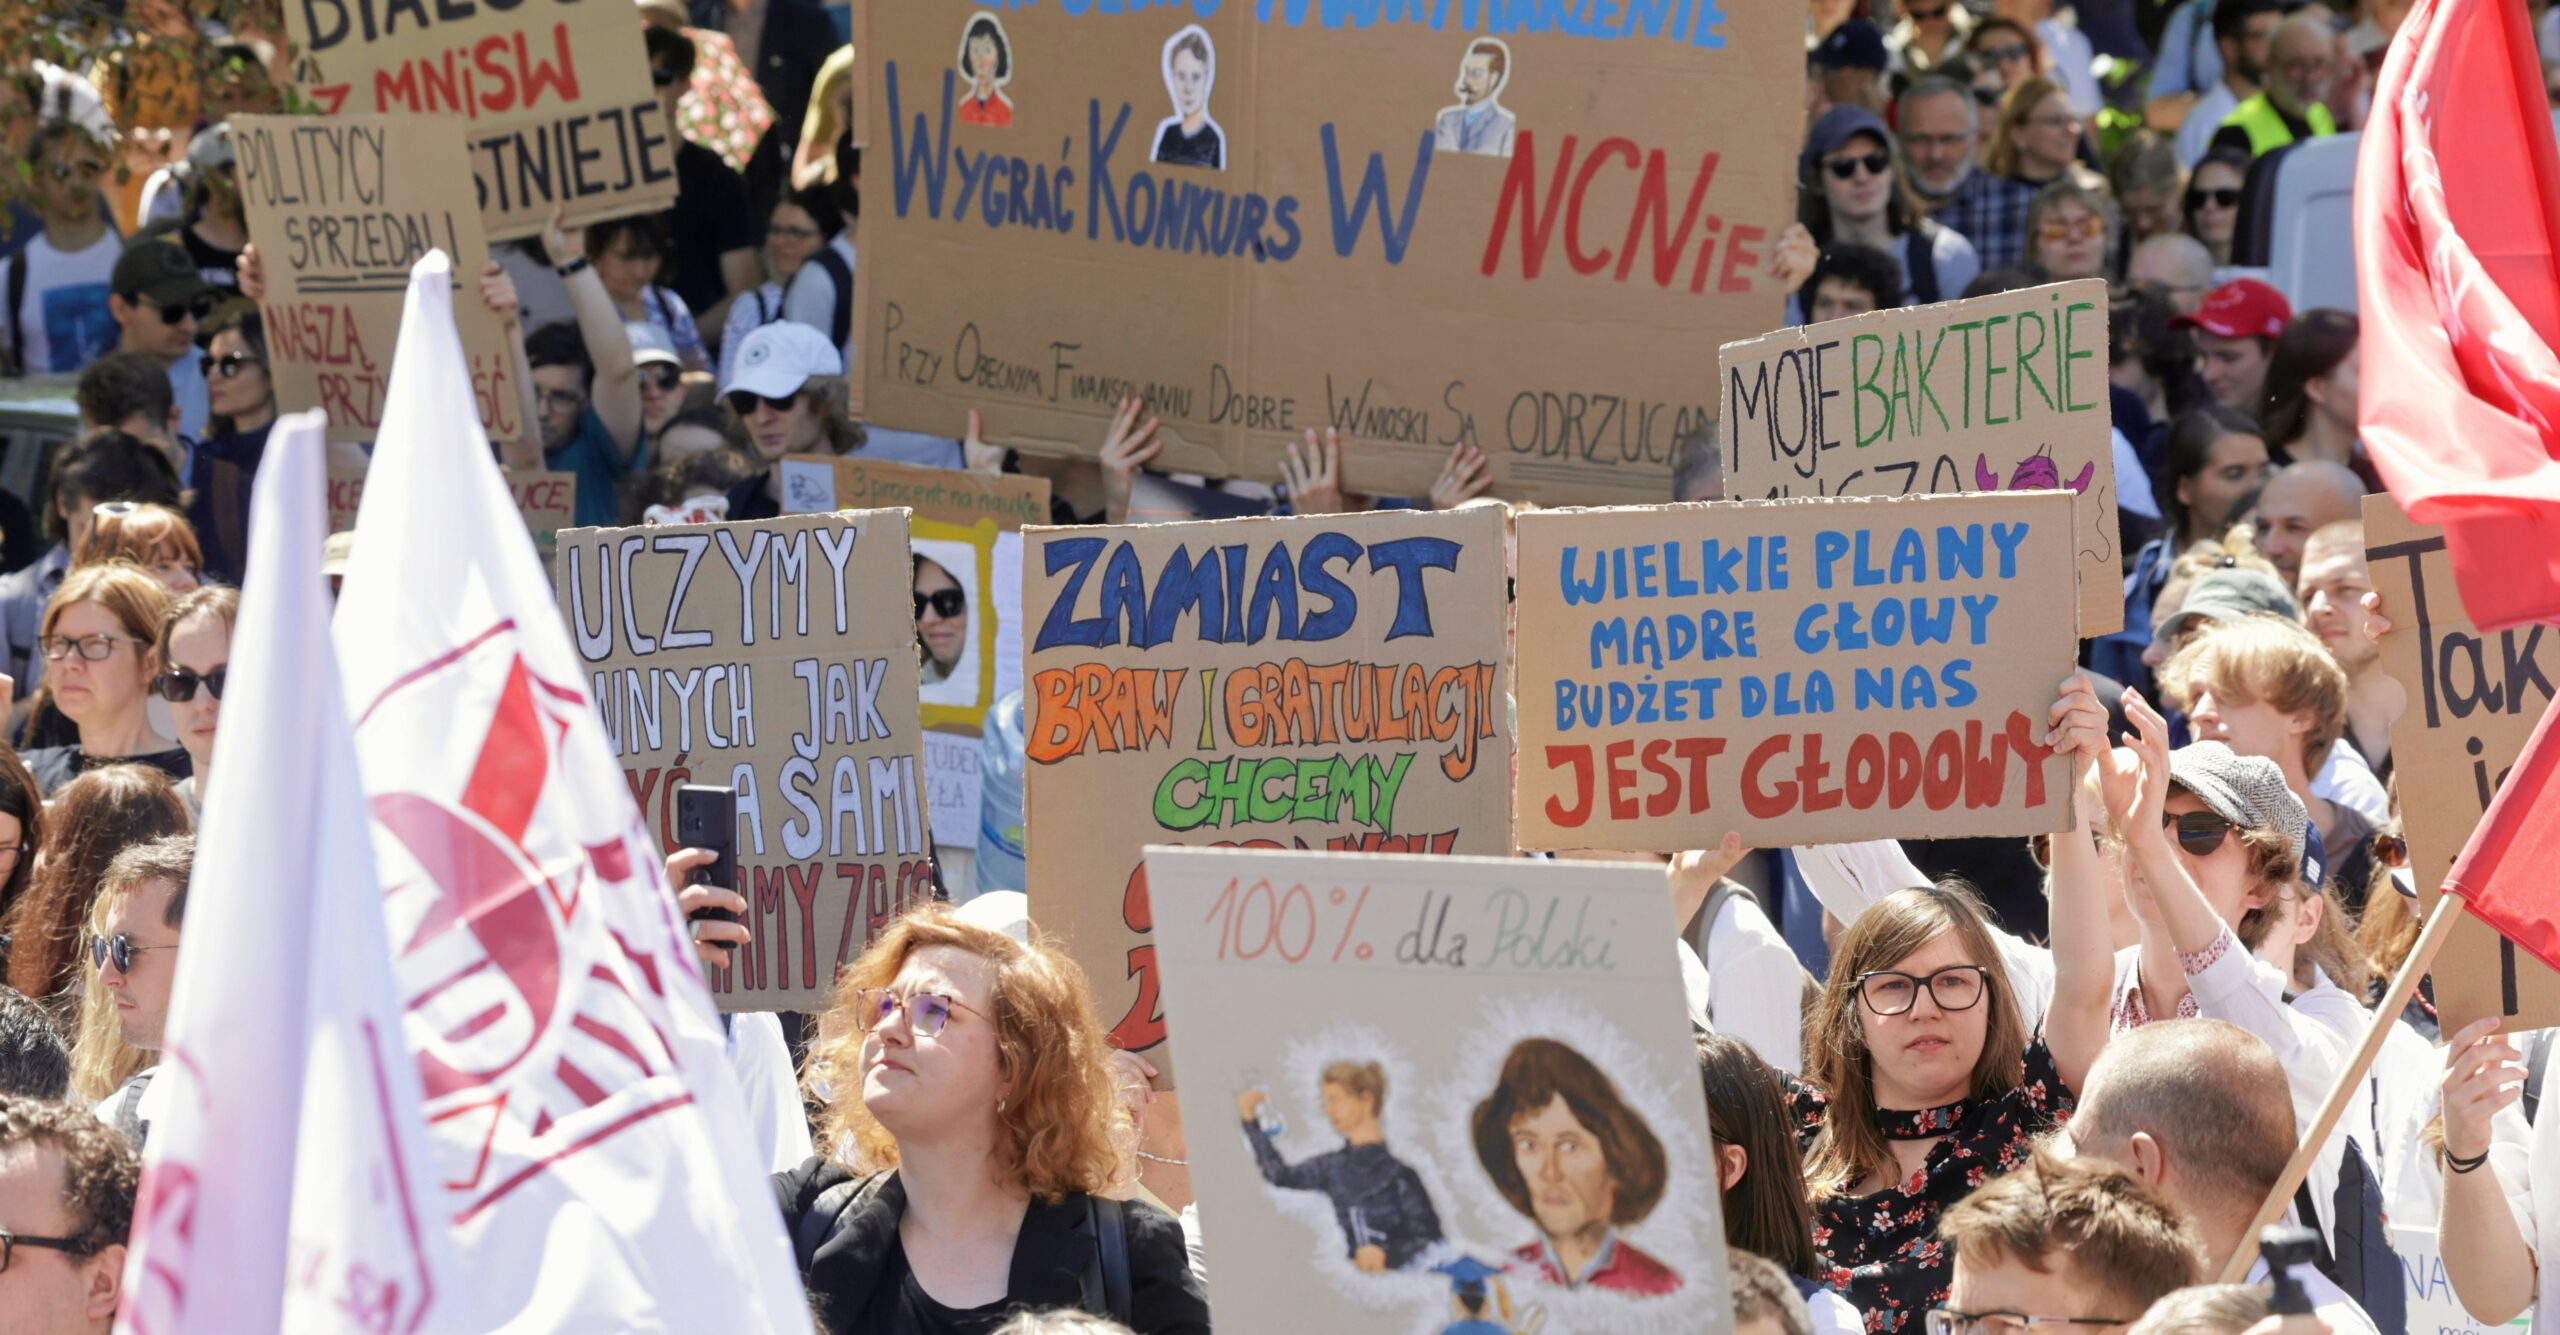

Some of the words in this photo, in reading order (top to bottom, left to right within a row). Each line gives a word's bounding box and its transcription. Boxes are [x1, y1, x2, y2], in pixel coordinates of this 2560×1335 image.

[238, 126, 386, 206] POLITYCY
[886, 61, 1075, 235] WYGRAĆ
[1087, 98, 1302, 263] KONKURS
[1320, 122, 1436, 265] W
[266, 302, 375, 373] NASZĄ
[883, 301, 942, 386] PRZY
[954, 322, 1043, 398] OBECNYM
[1207, 363, 1297, 431] DOBRE
[1326, 372, 1429, 445] WNIOSKI
[1731, 340, 1841, 478] MOJE
[852, 467, 866, 498] 3
[569, 526, 857, 663] UCZYMY
[1031, 531, 1464, 654] ZAMIAST
[1559, 534, 1790, 606] WIELKIE
[1814, 521, 2030, 590] PLANY
[1589, 609, 1759, 671] MĄDRE
[1793, 593, 1999, 655] GŁOWY
[593, 662, 756, 757] NNYCH
[792, 657, 892, 761] JAK
[1025, 661, 1189, 765] BRAW
[1197, 668, 1218, 751] I
[1222, 656, 1497, 783] GRATULACJI
[1554, 673, 1723, 732] BUDŻET
[1739, 669, 1835, 717] DLA
[1853, 658, 1979, 711] NAS
[731, 762, 766, 856] A
[777, 754, 924, 861] SAMI
[1152, 751, 1418, 837] CHCEMY
[1544, 736, 1728, 829] JEST
[1739, 708, 2056, 820] GŁODOWY
[1204, 875, 1376, 964] 100%
[1395, 888, 1468, 968] dla
[1478, 887, 1619, 972] Polski
